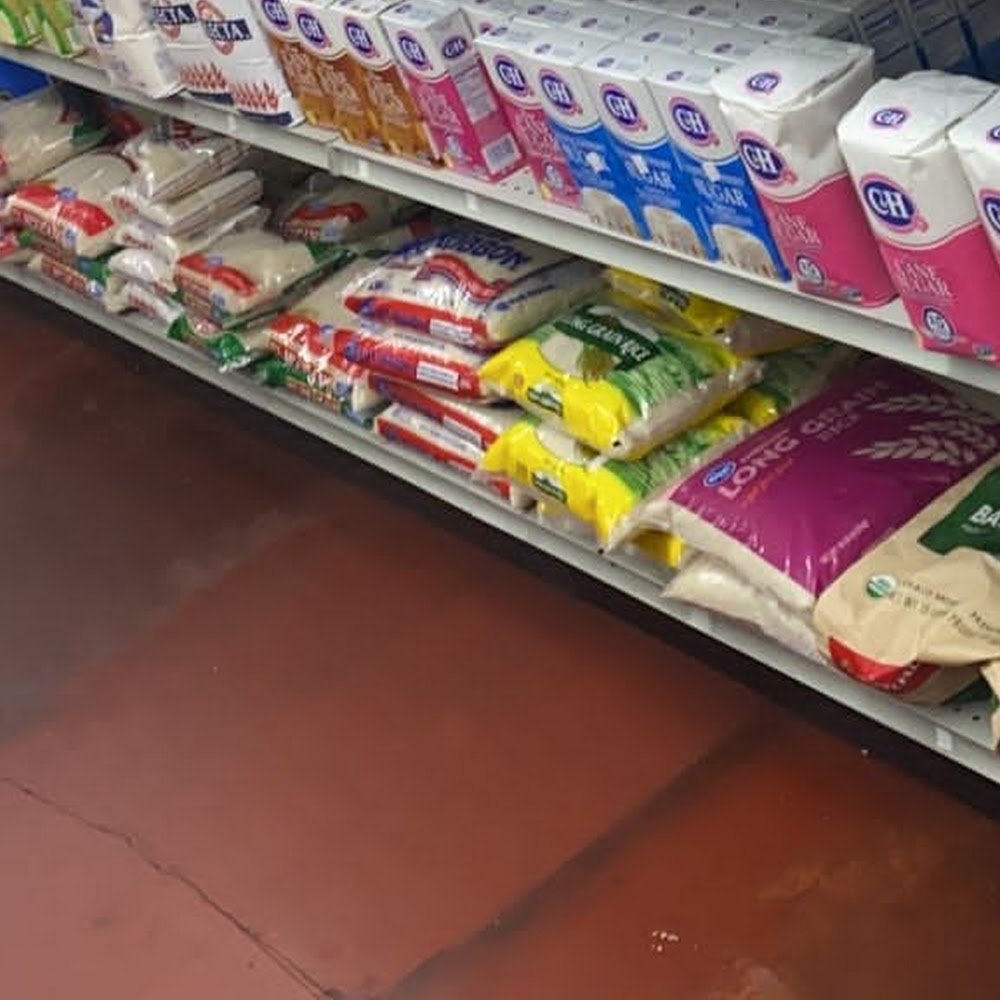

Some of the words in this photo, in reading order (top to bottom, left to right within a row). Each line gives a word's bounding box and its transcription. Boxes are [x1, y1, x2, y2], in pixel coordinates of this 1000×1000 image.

[744, 144, 778, 176] C&H
[866, 187, 910, 221] C&H
[717, 436, 800, 500] LONG
